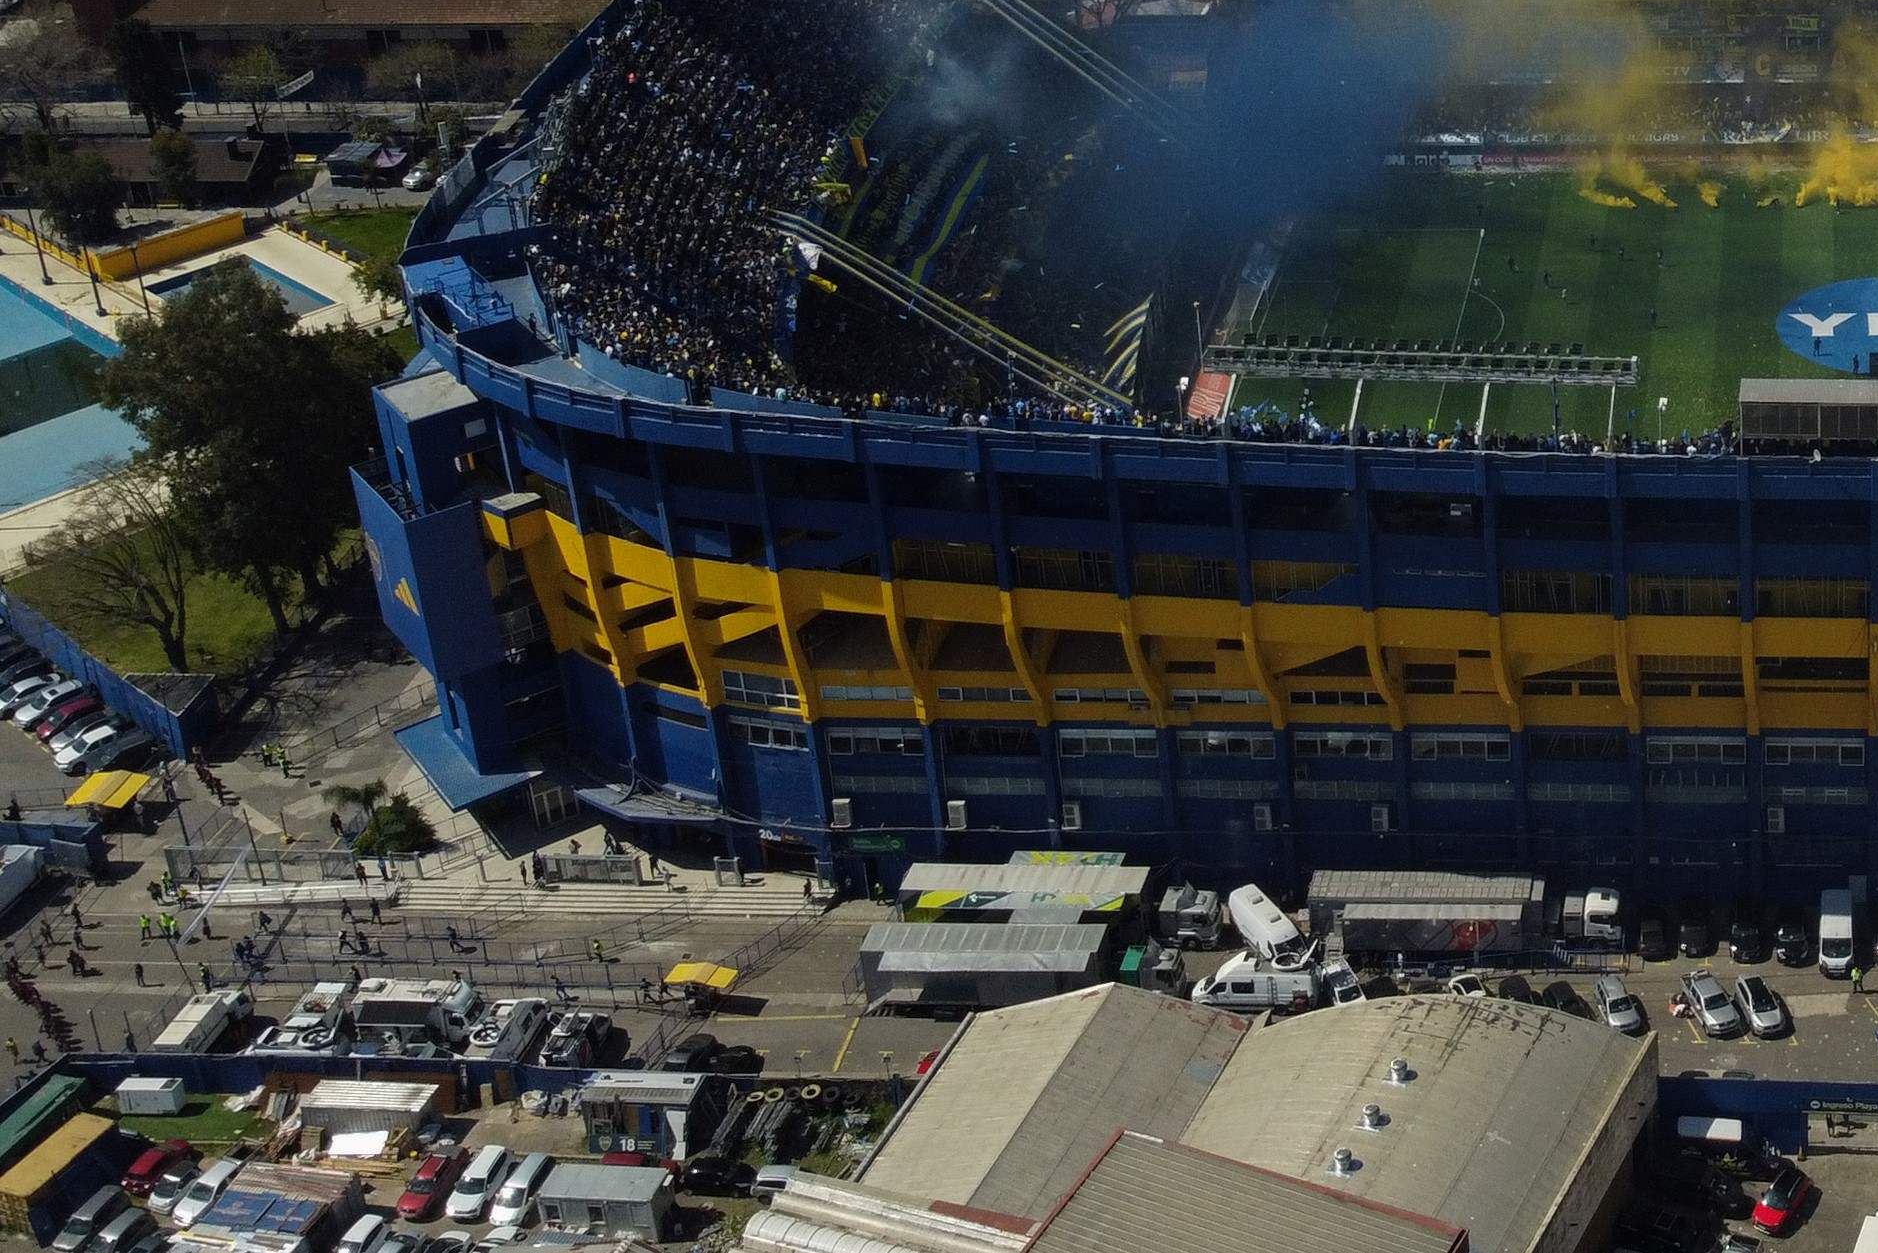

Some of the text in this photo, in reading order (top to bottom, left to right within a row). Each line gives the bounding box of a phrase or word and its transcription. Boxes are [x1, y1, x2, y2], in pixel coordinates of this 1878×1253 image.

[1822, 1102, 1853, 1110] Ingreso
[1855, 1102, 1878, 1111] Playa
[619, 1139, 635, 1152] 18
